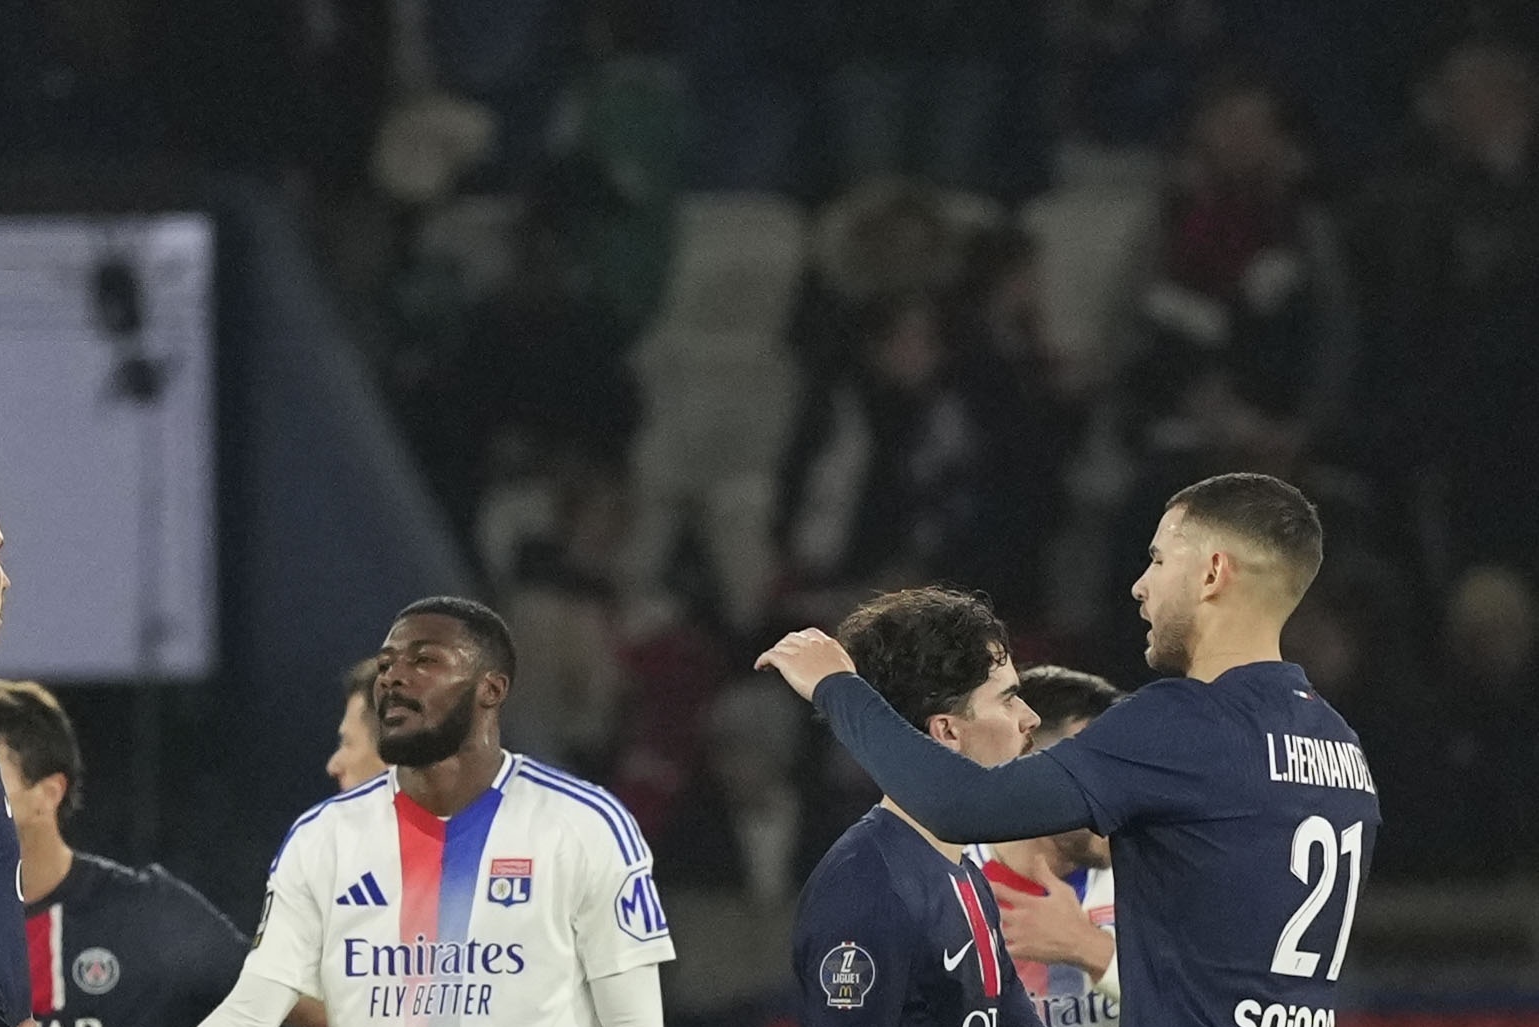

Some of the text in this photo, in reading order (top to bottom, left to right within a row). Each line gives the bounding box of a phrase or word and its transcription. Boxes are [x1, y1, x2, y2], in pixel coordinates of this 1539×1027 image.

[1271, 815, 1363, 981] 21
[345, 935, 524, 977] Emirates
[370, 984, 492, 1018] FLY BETTER
